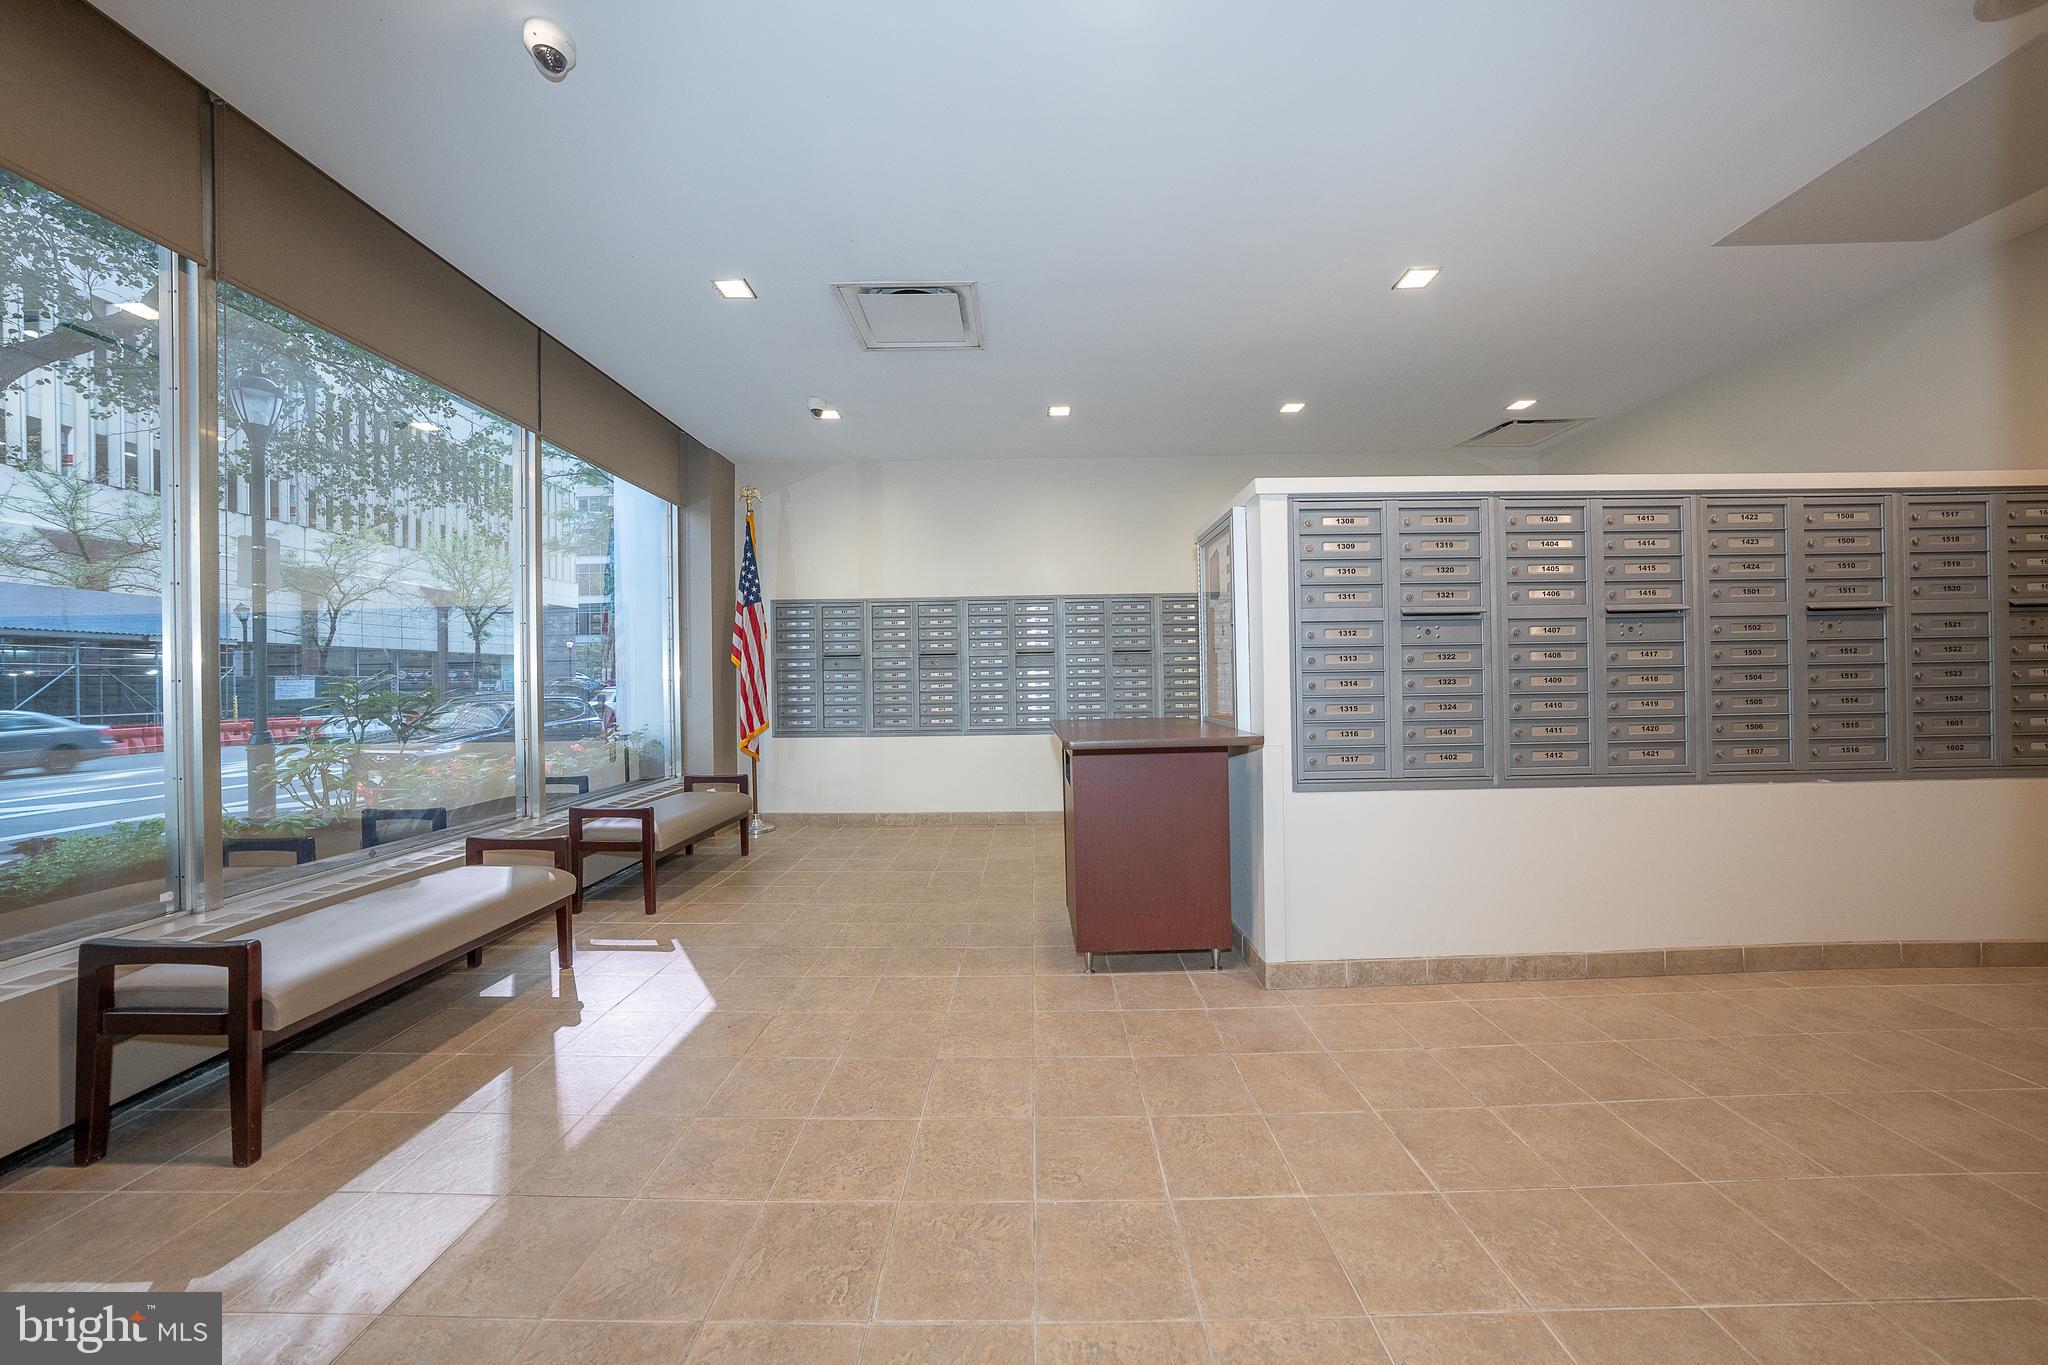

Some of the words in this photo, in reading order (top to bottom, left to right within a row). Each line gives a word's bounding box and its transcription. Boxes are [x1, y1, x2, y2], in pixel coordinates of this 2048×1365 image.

[1338, 629, 1357, 637] 1312
[1840, 647, 1858, 655] 1512
[1944, 645, 1962, 653] 1522
[1744, 673, 1762, 681] 1504
[1438, 703, 1457, 711] 1324
[1841, 721, 1860, 729] 1515
[1439, 728, 1456, 736] 1401
[1545, 751, 1563, 759] 1412
